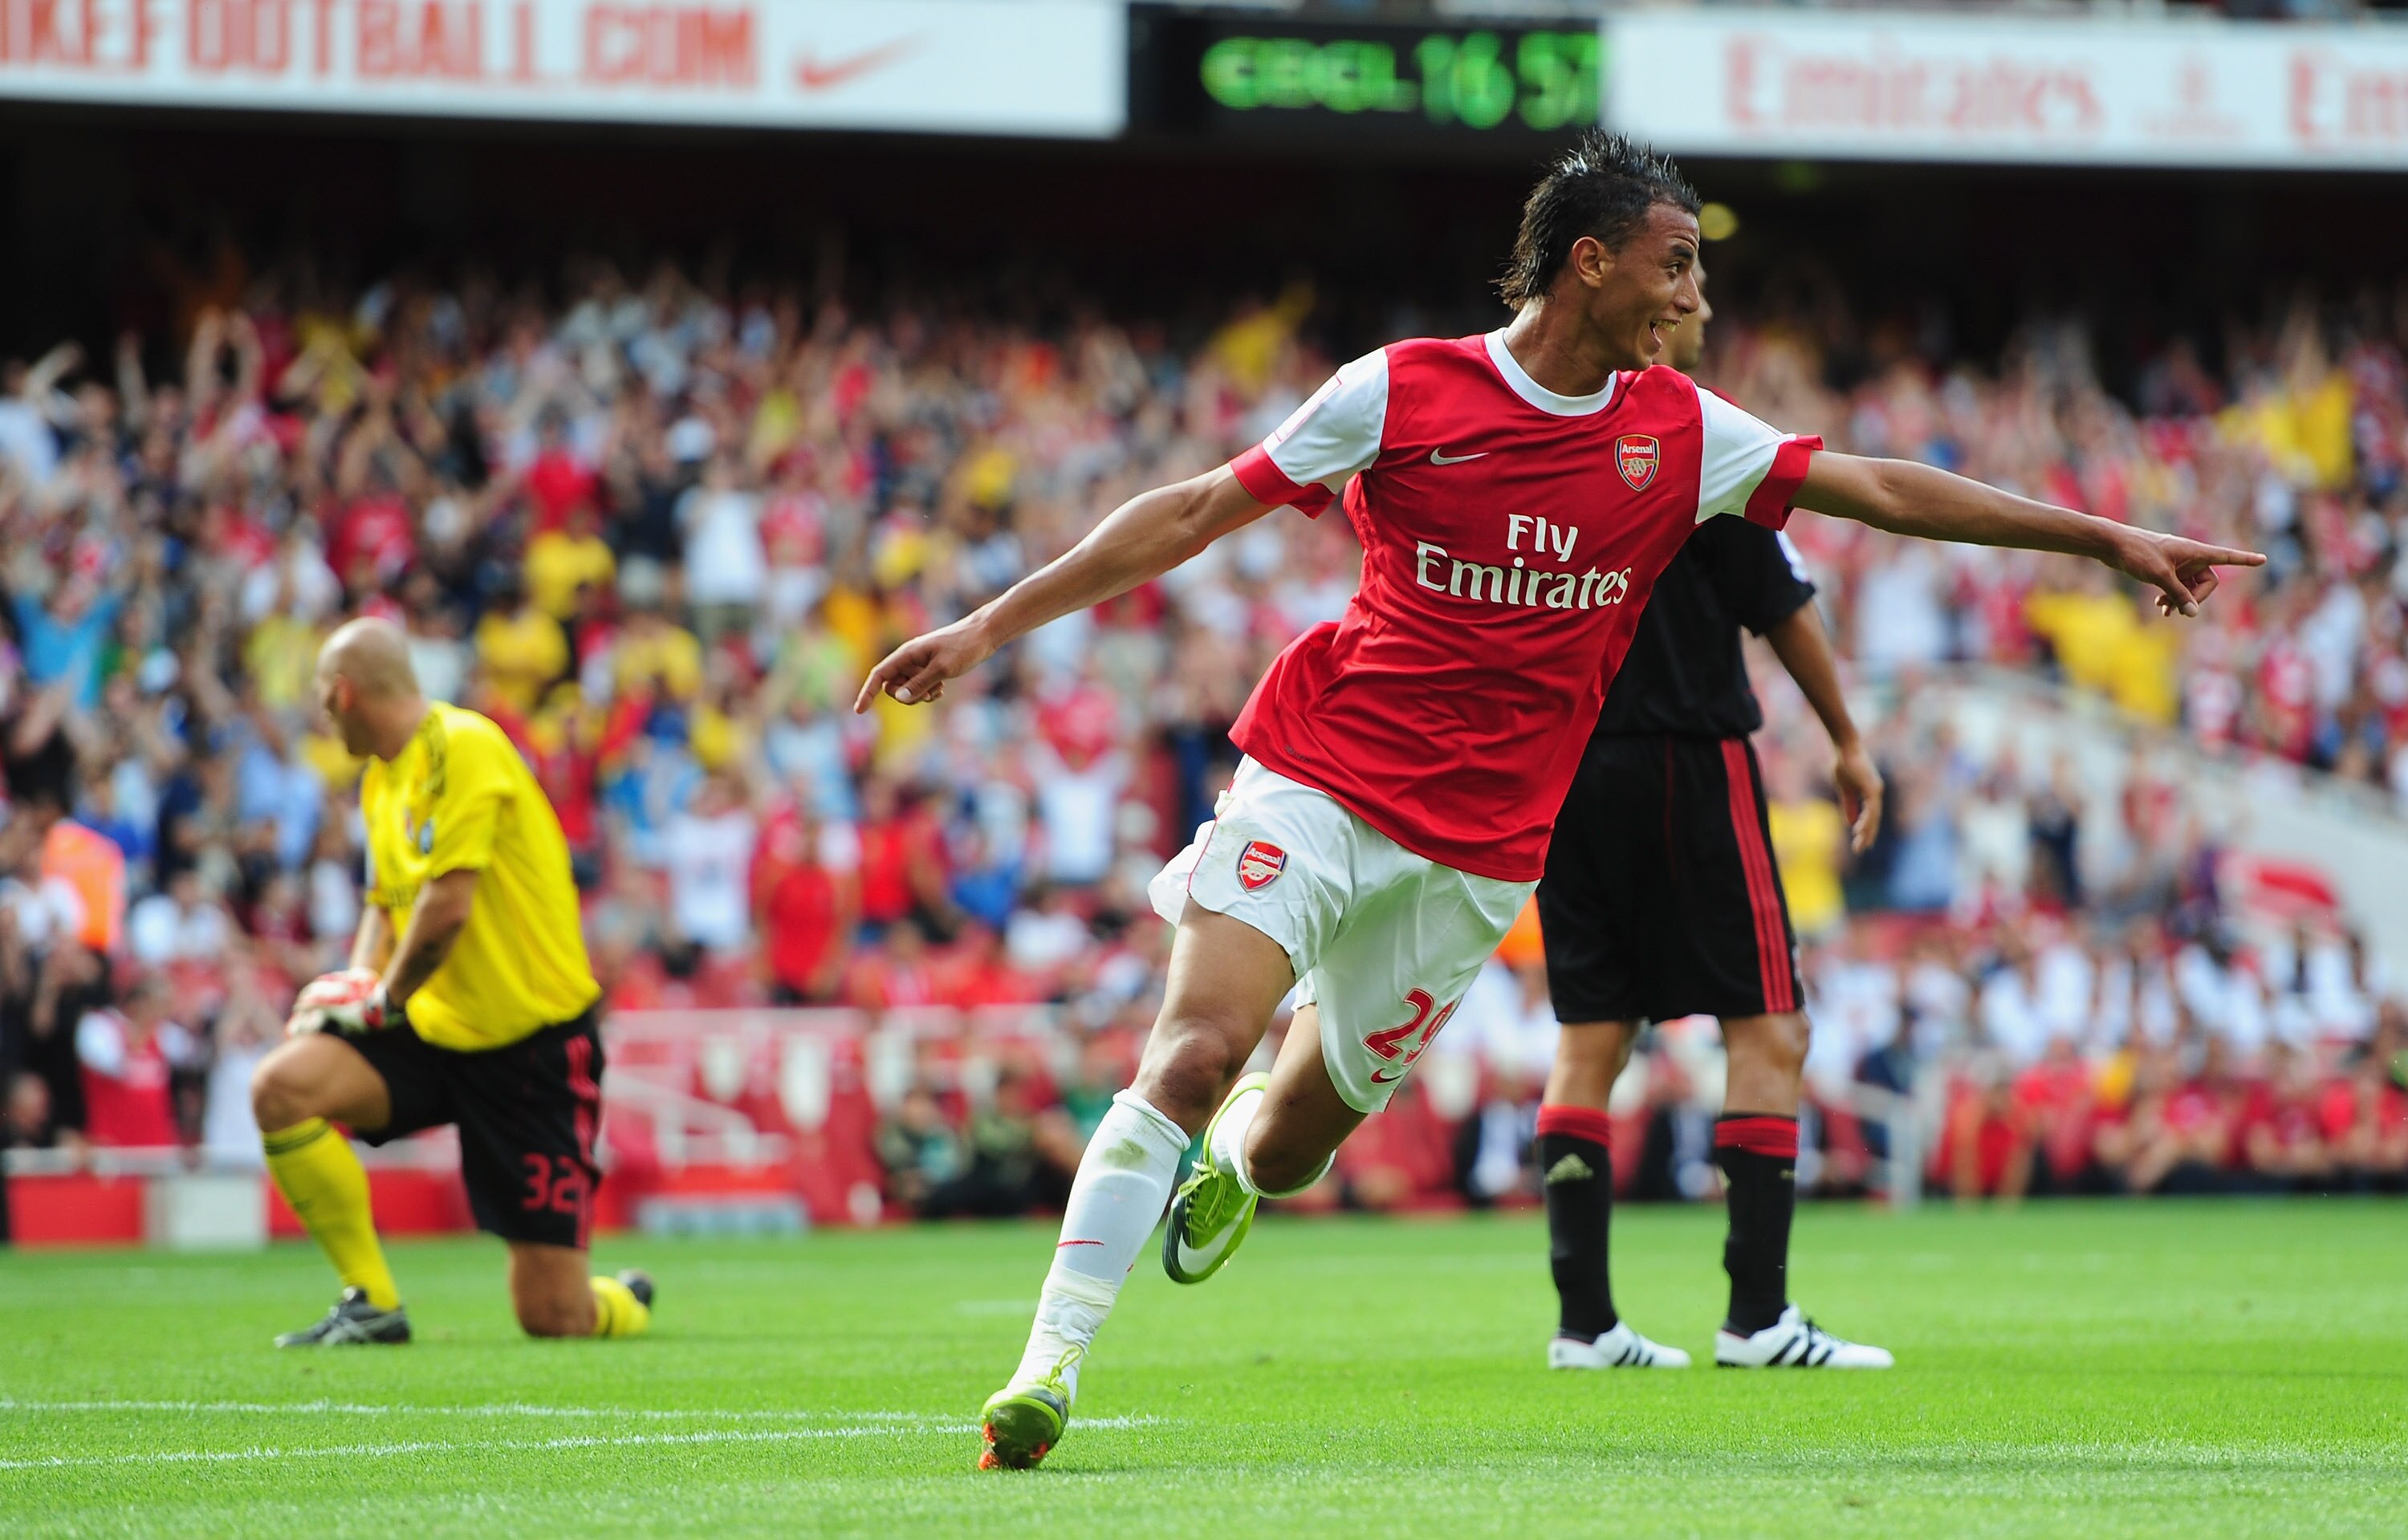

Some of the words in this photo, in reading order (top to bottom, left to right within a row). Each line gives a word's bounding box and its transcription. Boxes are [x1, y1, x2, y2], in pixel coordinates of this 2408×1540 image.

[1723, 29, 2103, 131] Emirates
[1622, 444, 1653, 453] Arsenal
[1507, 514, 1579, 562] Fly
[1416, 540, 1632, 610] Emirates
[1247, 847, 1281, 865] Arsenal
[522, 1153, 591, 1213] 32
